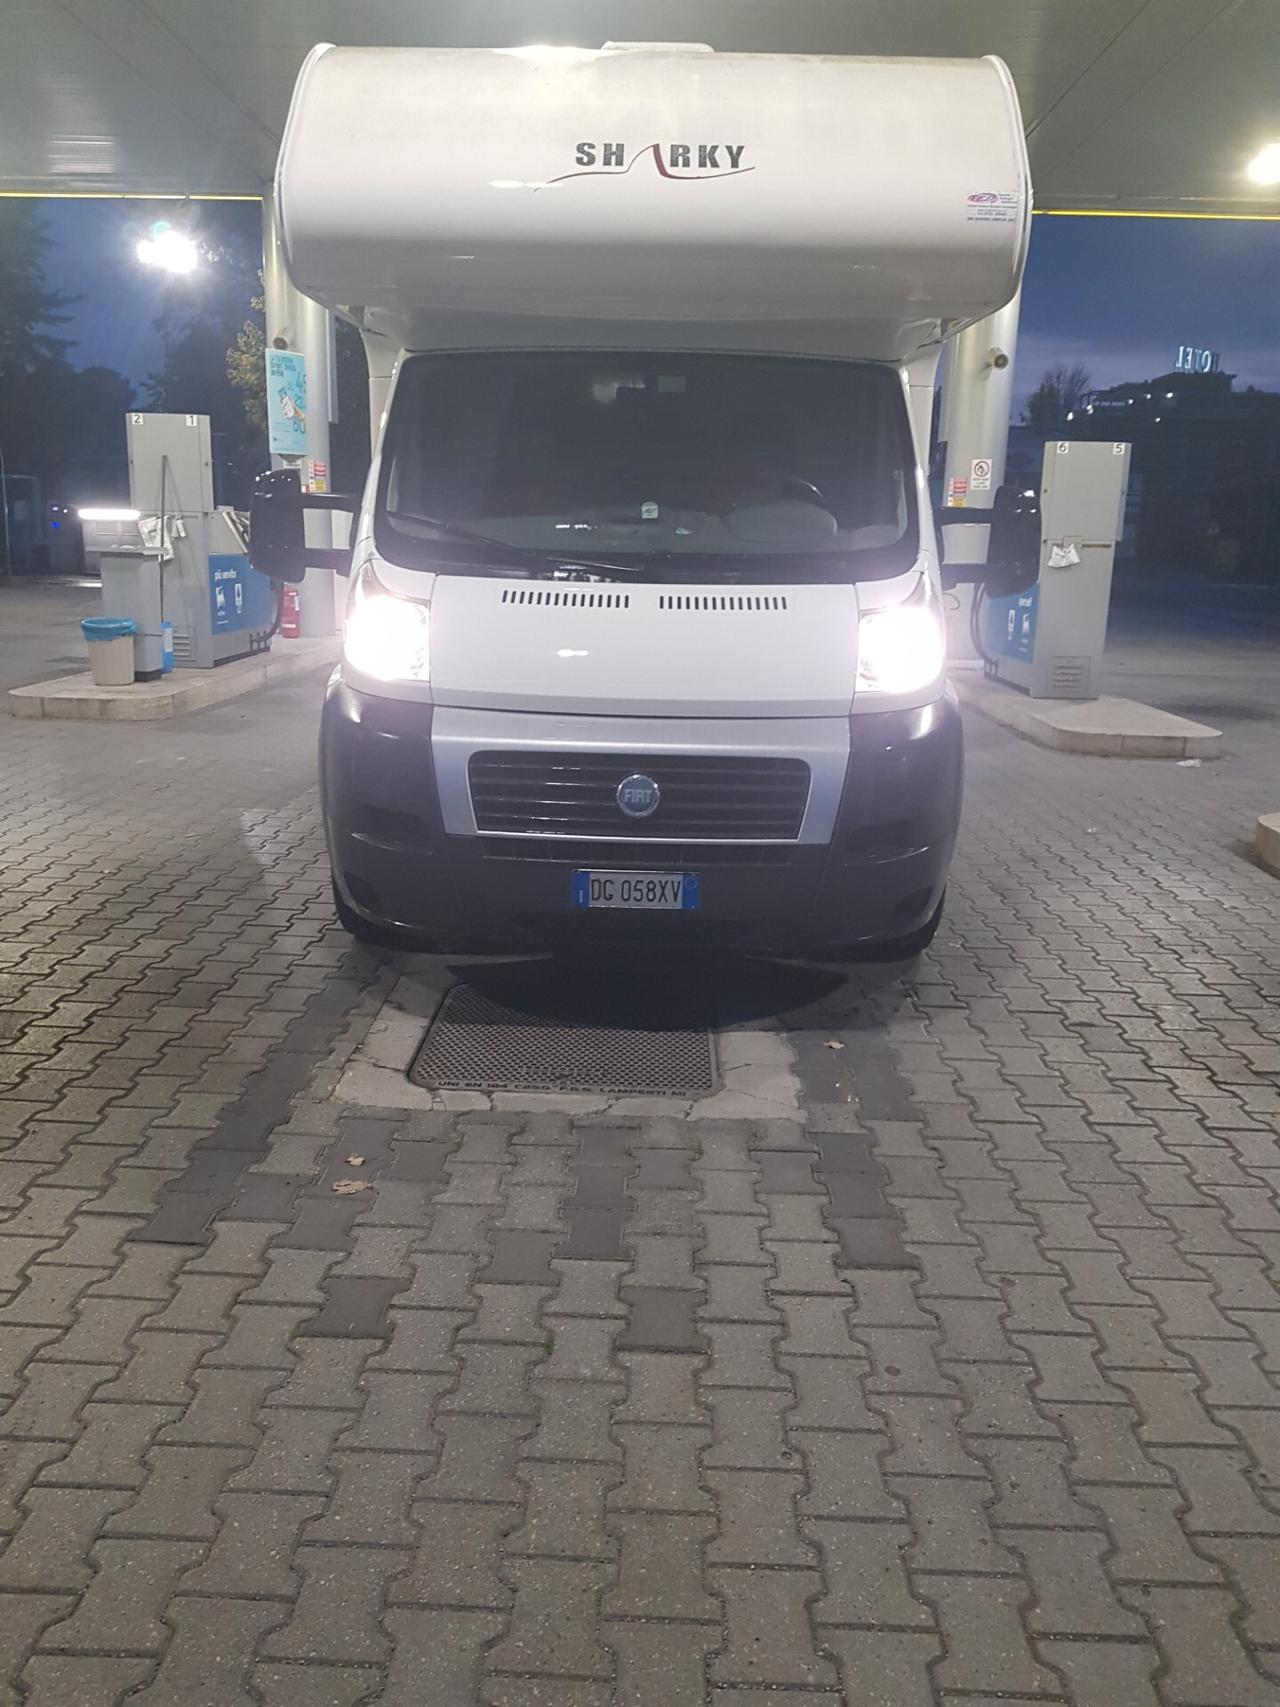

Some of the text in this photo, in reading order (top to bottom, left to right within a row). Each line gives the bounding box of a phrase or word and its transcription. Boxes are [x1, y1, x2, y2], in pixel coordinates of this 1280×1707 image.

[133, 413, 142, 424] 2
[1059, 442, 1067, 453] 6
[1115, 443, 1123, 454] 5
[623, 788, 652, 803] FIAT
[620, 879, 681, 903] 058XV
